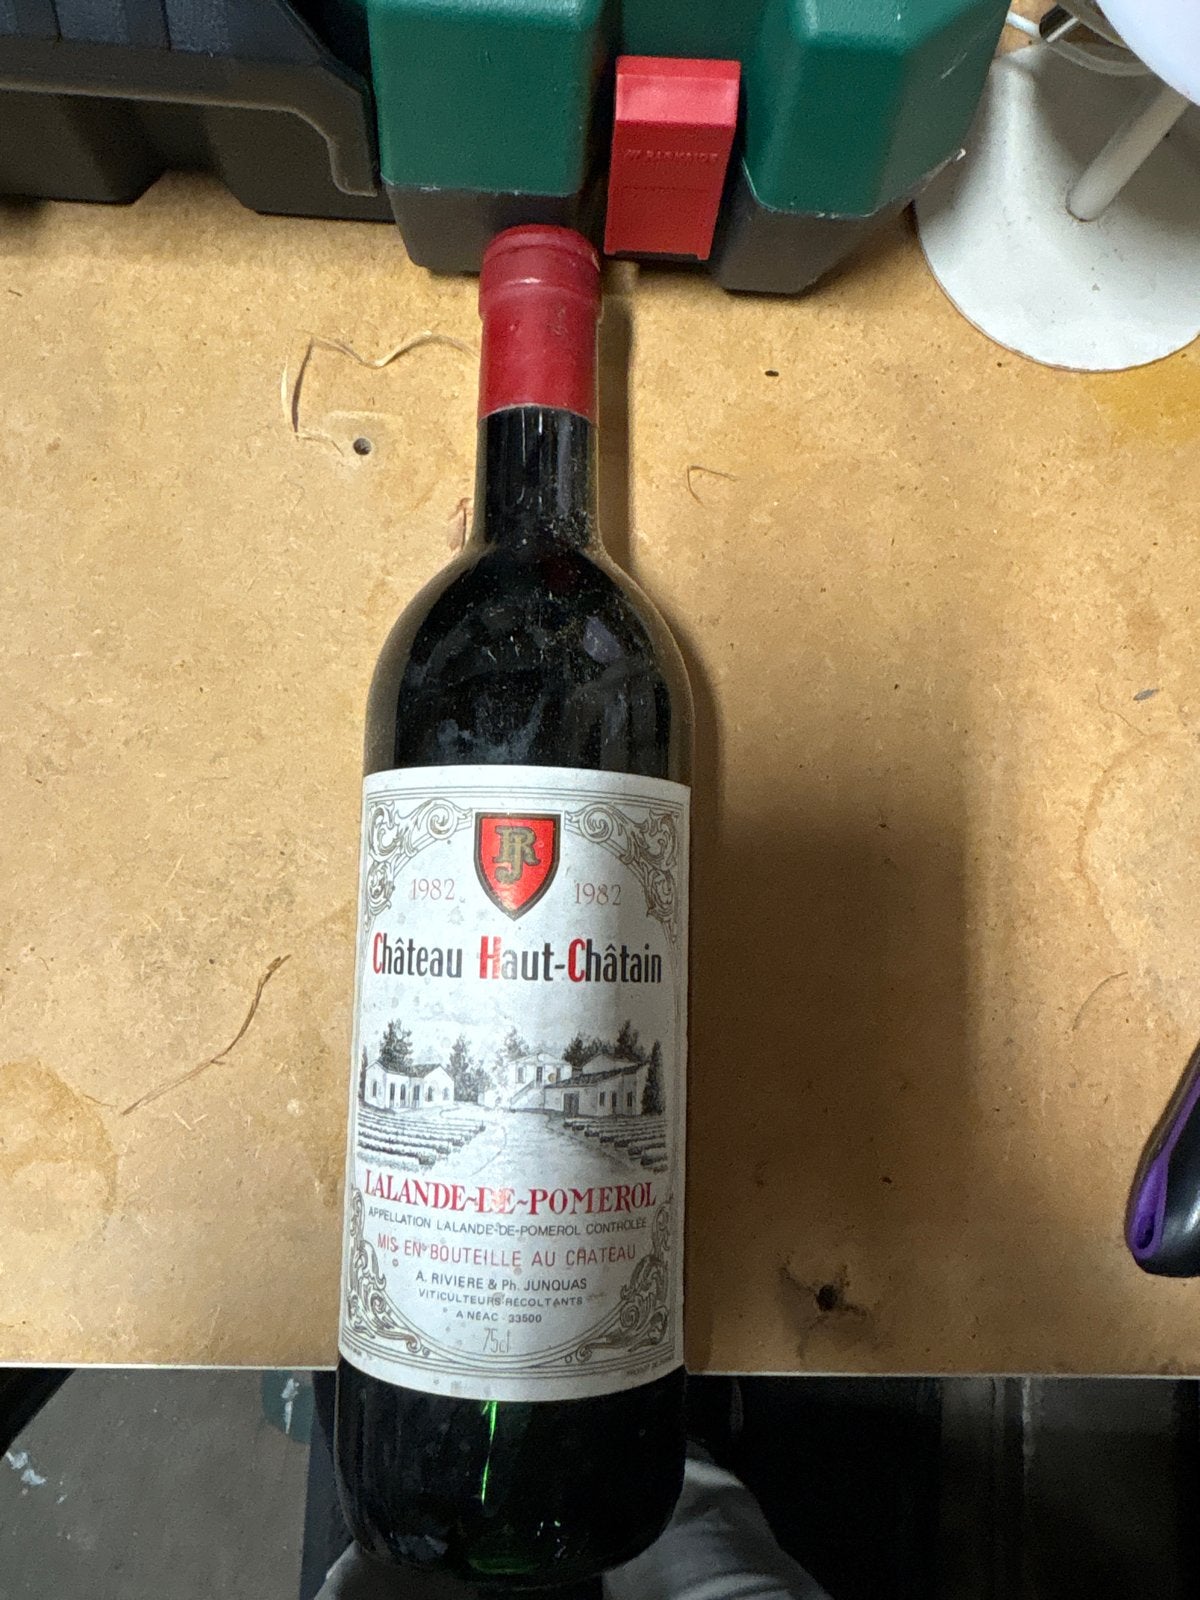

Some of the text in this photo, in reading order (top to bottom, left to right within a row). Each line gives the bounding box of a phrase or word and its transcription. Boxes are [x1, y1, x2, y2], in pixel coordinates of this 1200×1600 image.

[411, 878, 455, 900] 1982
[574, 882, 621, 905] 1982
[373, 932, 661, 983] Château Haut-Châtain
[369, 1206, 431, 1228] APPELLATION
[437, 1222, 581, 1237] LALANDE-DE-POMEROL
[378, 1233, 398, 1252] MIS
[405, 1240, 421, 1257] EN
[431, 1244, 521, 1267] BOUTEILLE
[532, 1251, 555, 1267] AU
[416, 1270, 587, 1291] A. RIVIERE & Ph. JUNQUAS
[456, 1310, 464, 1319] A
[509, 1314, 542, 1323] 33500
